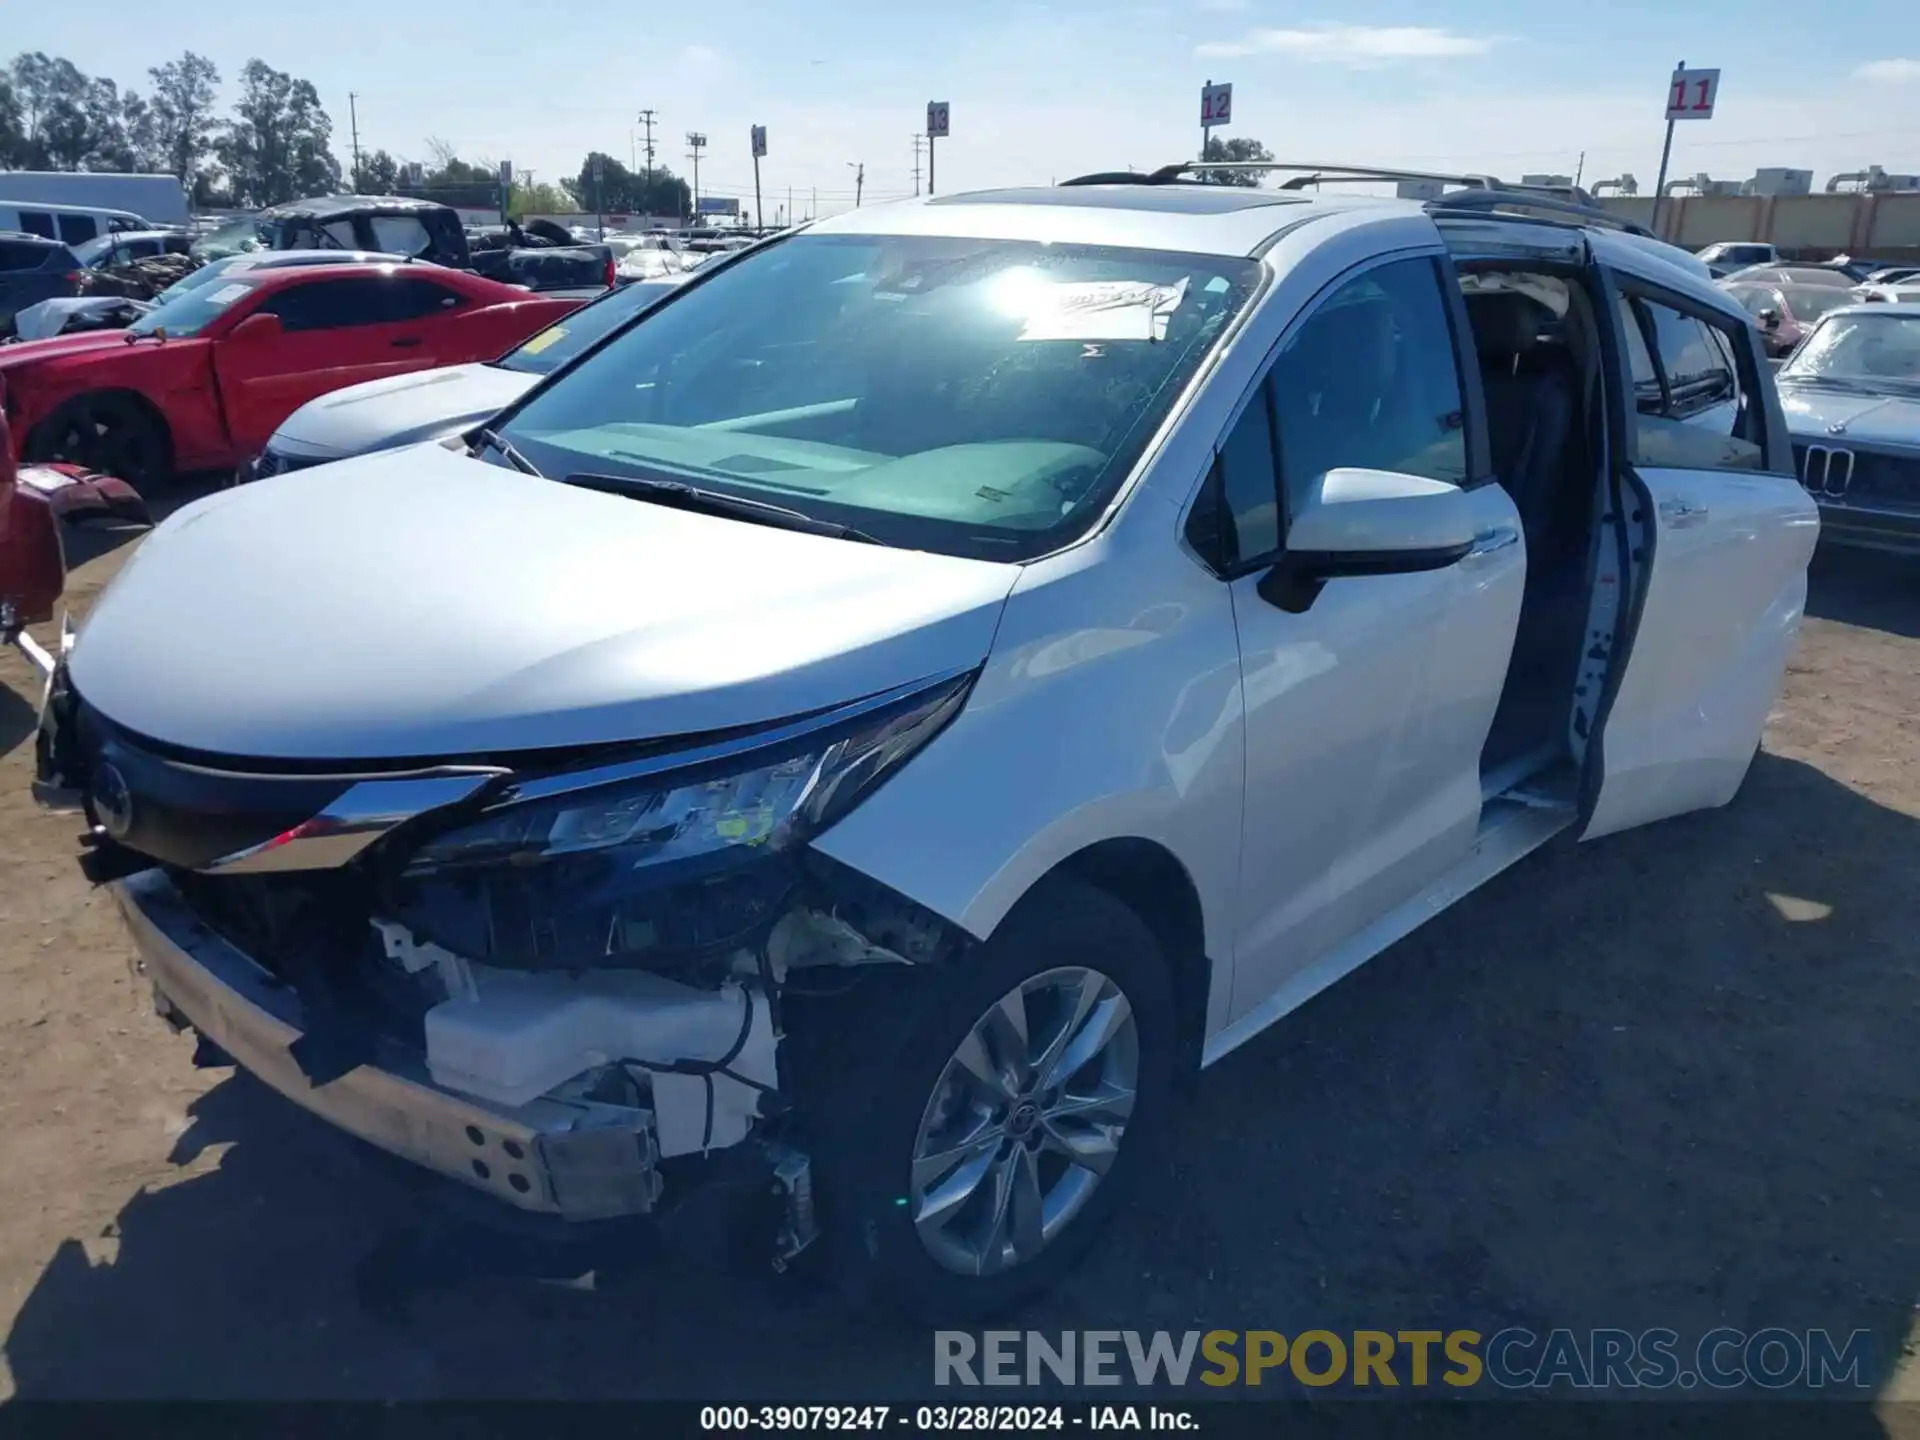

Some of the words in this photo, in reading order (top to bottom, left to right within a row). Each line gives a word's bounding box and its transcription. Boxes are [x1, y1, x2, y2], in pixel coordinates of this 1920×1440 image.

[1202, 93, 1229, 119] 12
[1669, 78, 1712, 111] 11
[928, 109, 949, 131] 13
